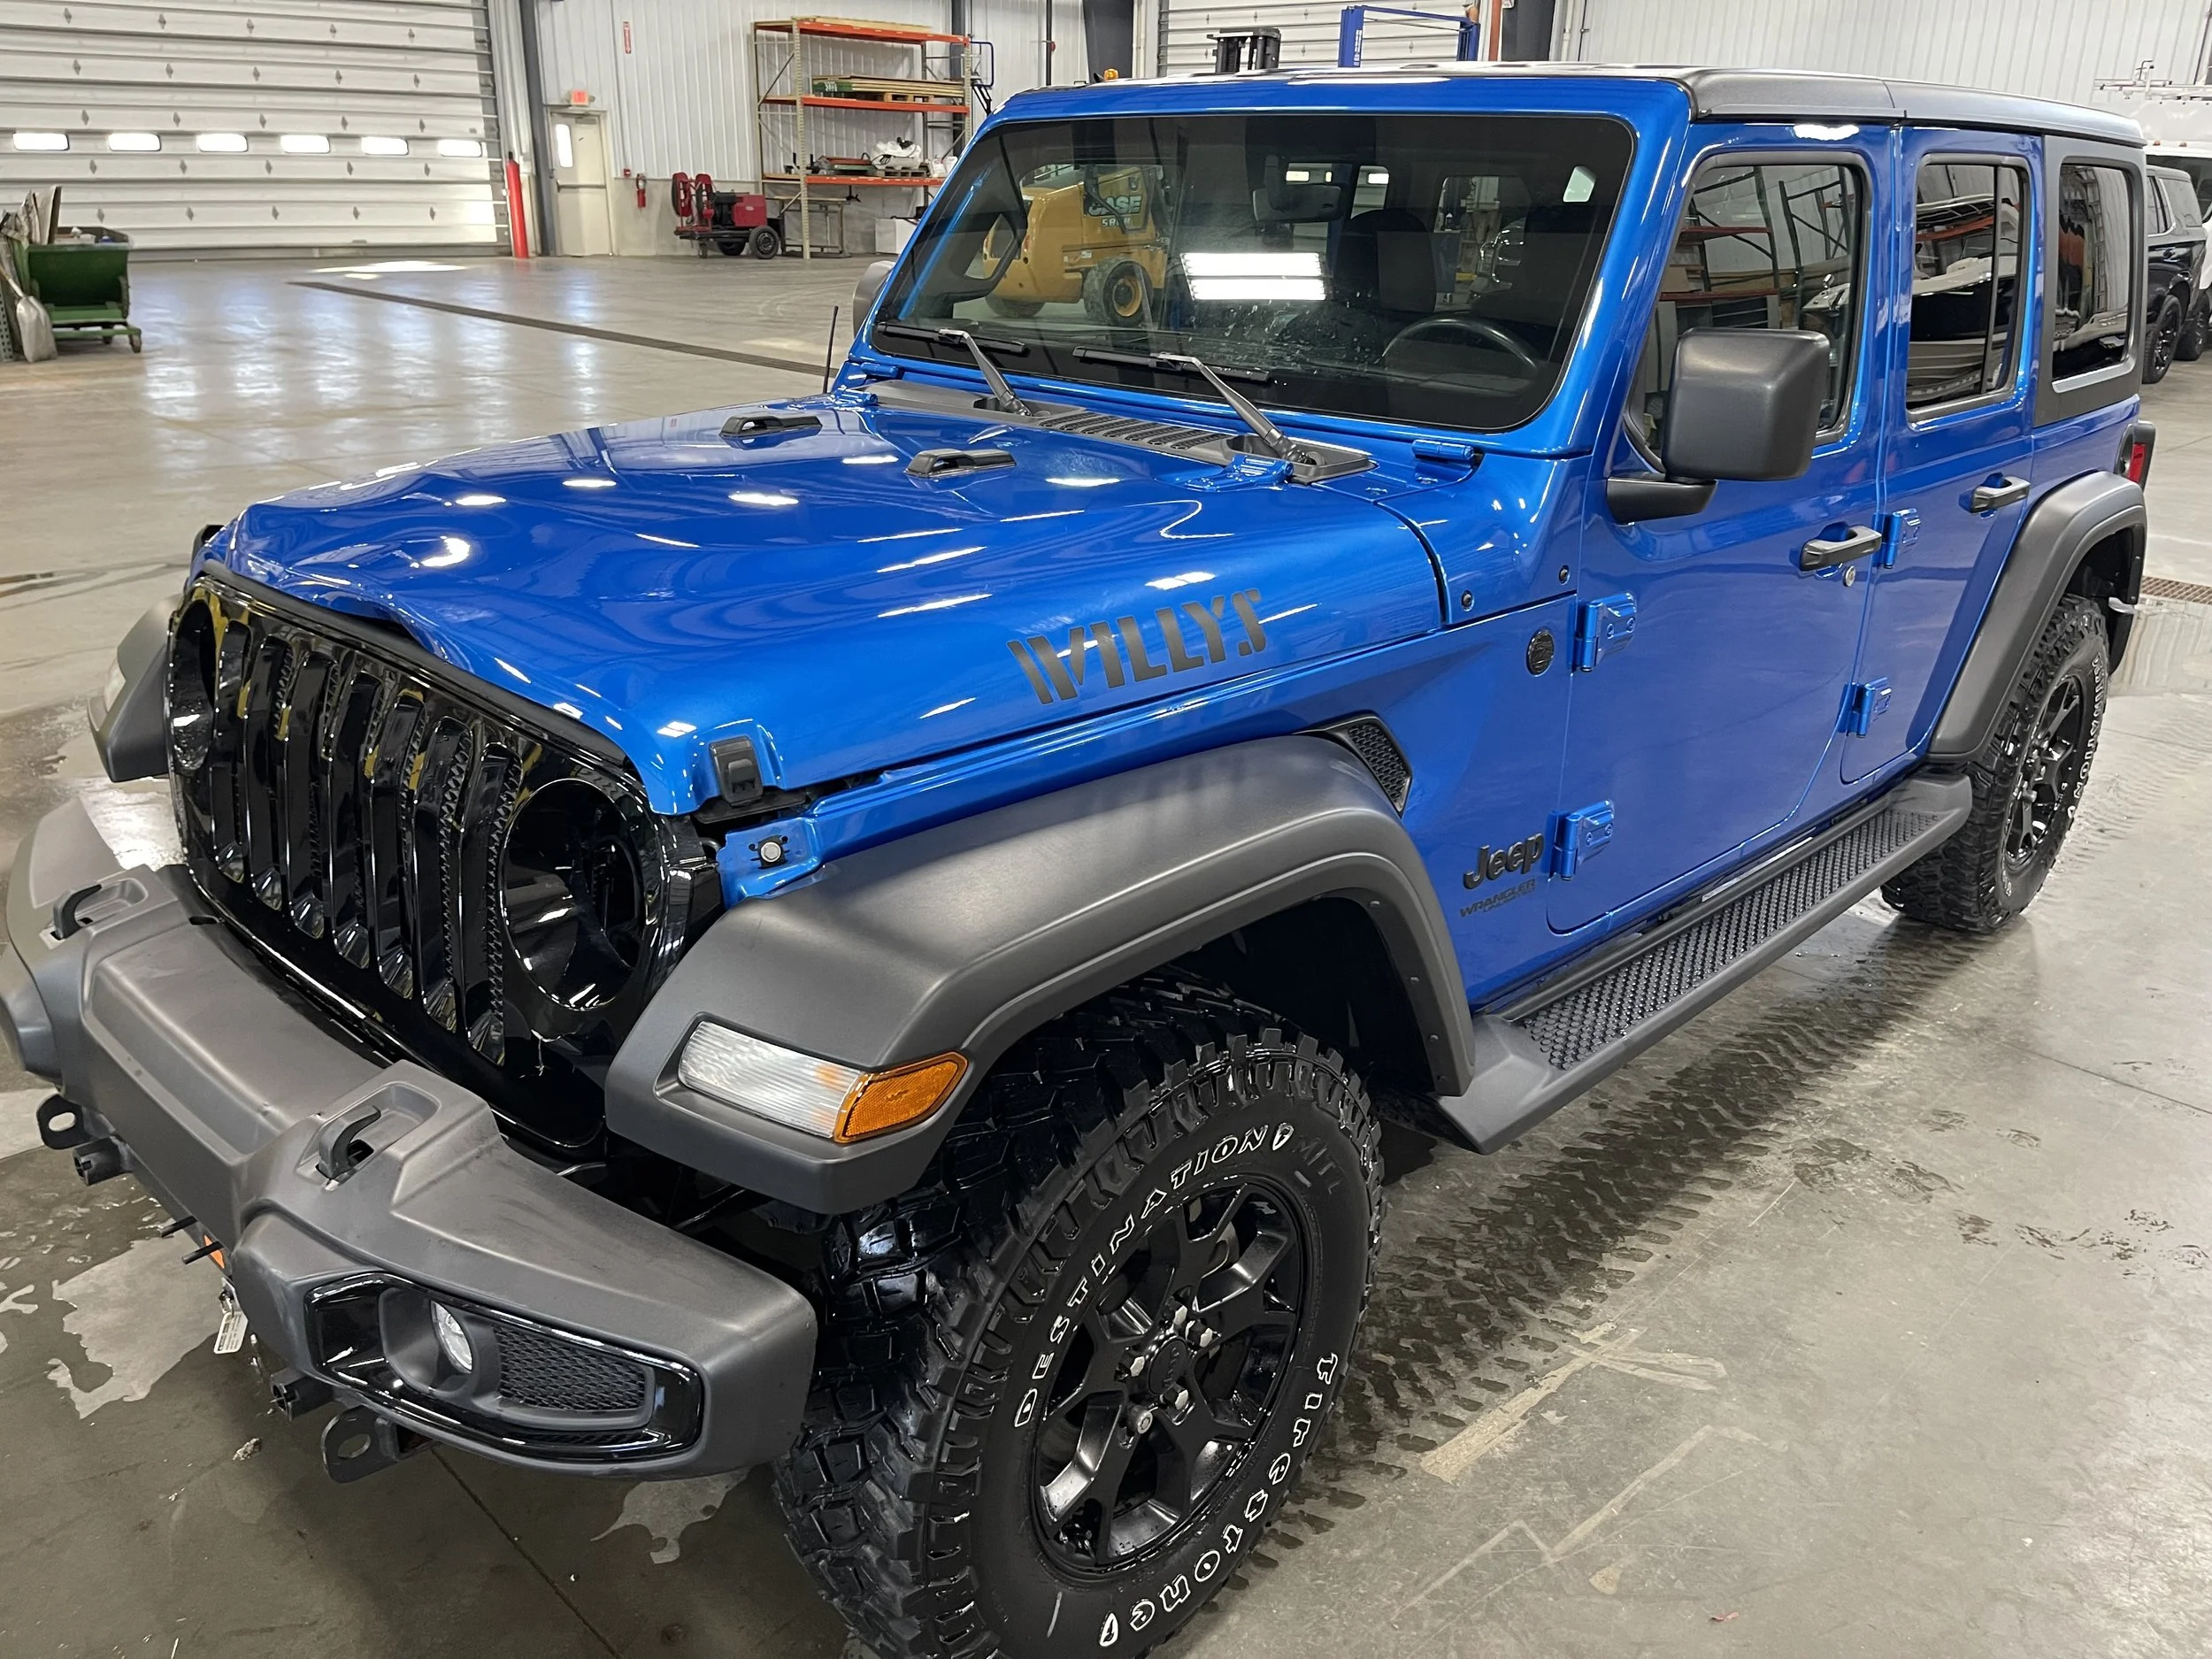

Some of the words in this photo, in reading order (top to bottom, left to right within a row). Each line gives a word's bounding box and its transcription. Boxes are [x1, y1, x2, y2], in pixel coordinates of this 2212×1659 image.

[1007, 588, 1267, 705] WILLYS
[1460, 879, 1536, 918] WRANGLER
[1463, 833, 1545, 890] Jeep
[1014, 1124, 1270, 1427] DESTINATION
